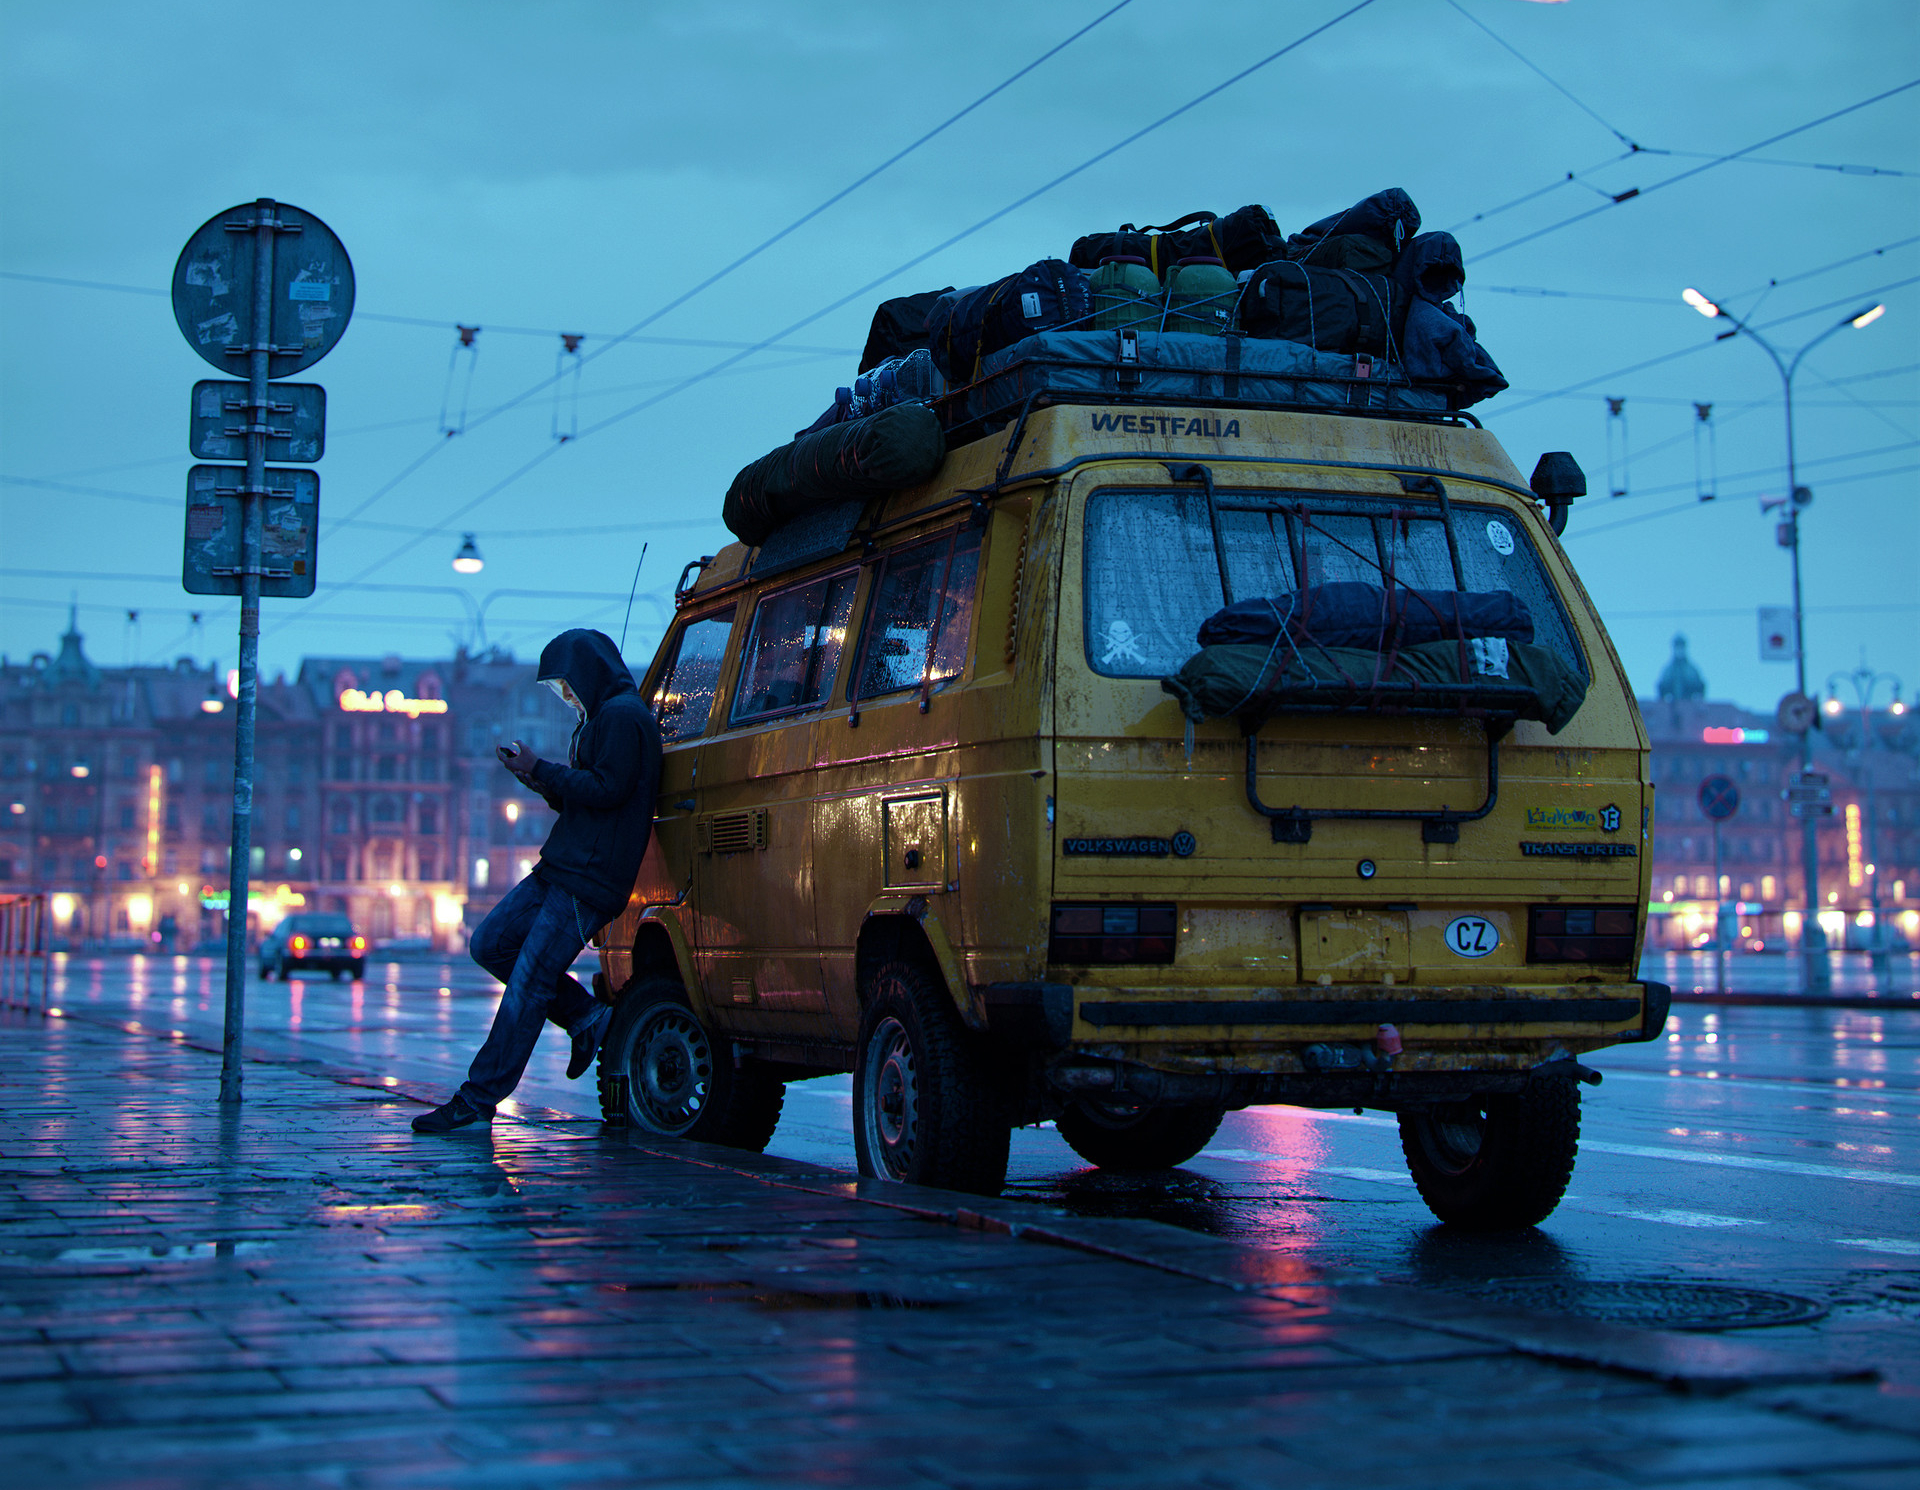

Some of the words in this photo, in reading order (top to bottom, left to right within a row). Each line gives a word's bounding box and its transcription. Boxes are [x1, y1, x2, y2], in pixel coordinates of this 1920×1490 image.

[1091, 412, 1240, 438] WESTFALIA
[1066, 839, 1169, 853] VOLKSWAGEN
[1521, 843, 1637, 856] TRANSPORTER
[1456, 922, 1488, 950] CZ
